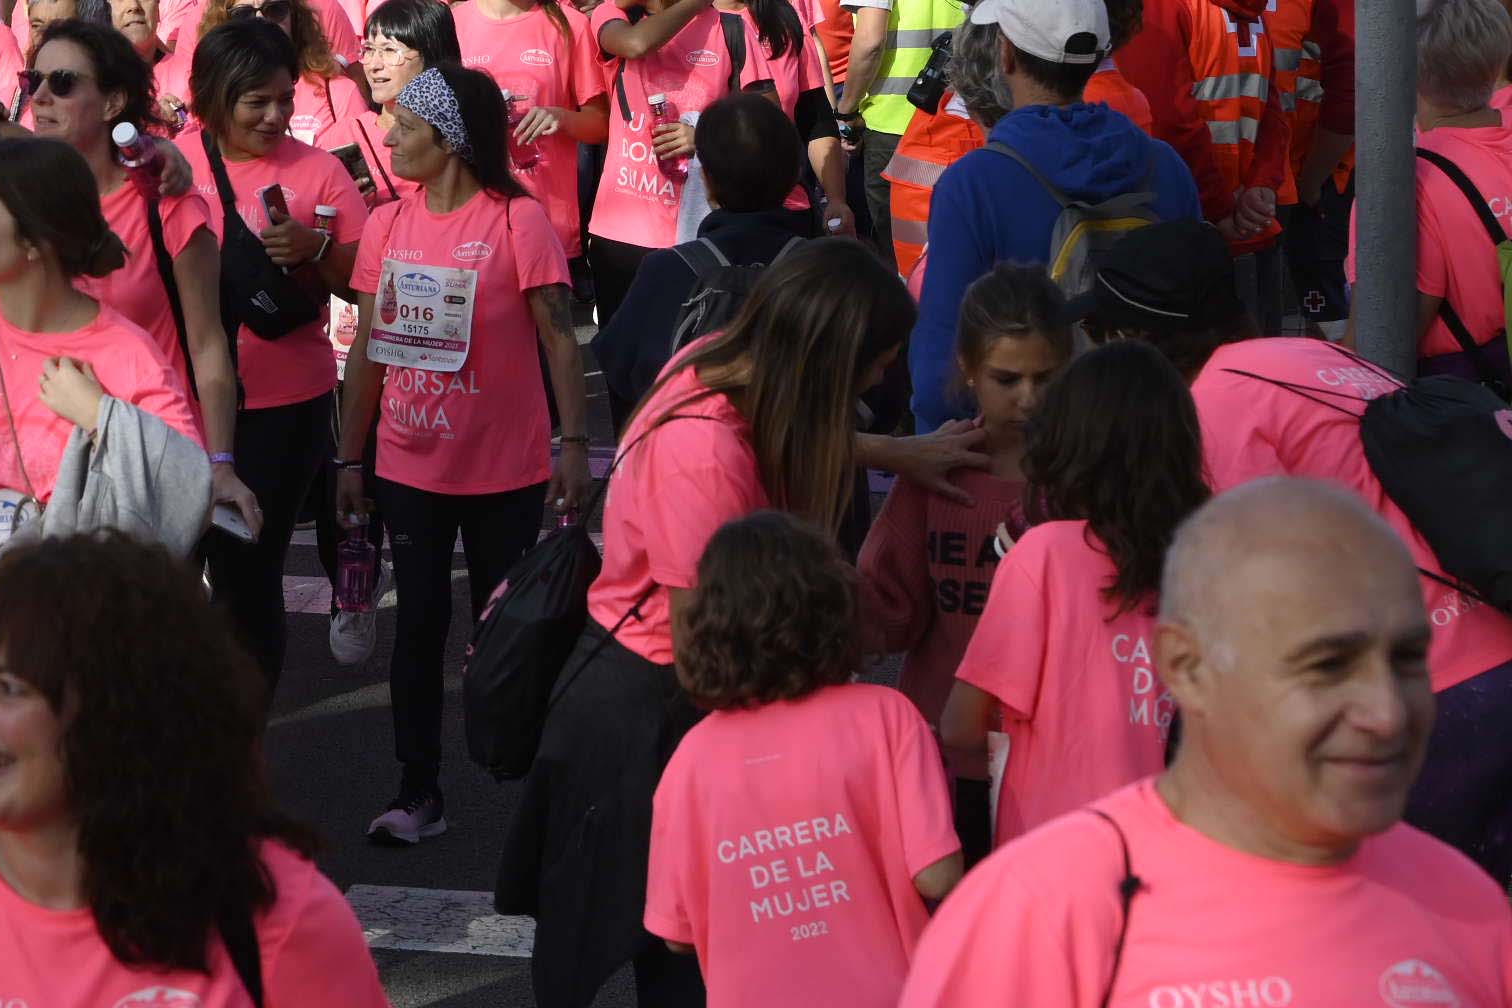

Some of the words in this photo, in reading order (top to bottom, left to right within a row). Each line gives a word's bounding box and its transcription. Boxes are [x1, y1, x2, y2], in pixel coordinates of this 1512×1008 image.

[616, 167, 676, 198] SUMA
[399, 280, 437, 294] ASTURIANA
[399, 304, 434, 322] 016
[402, 323, 429, 336] 15175
[389, 397, 451, 431] SUMA
[716, 813, 854, 865] CARRERA
[749, 859, 791, 890] DE
[796, 851, 835, 878] LA
[749, 879, 852, 924] MUJER
[790, 920, 829, 941] 2022
